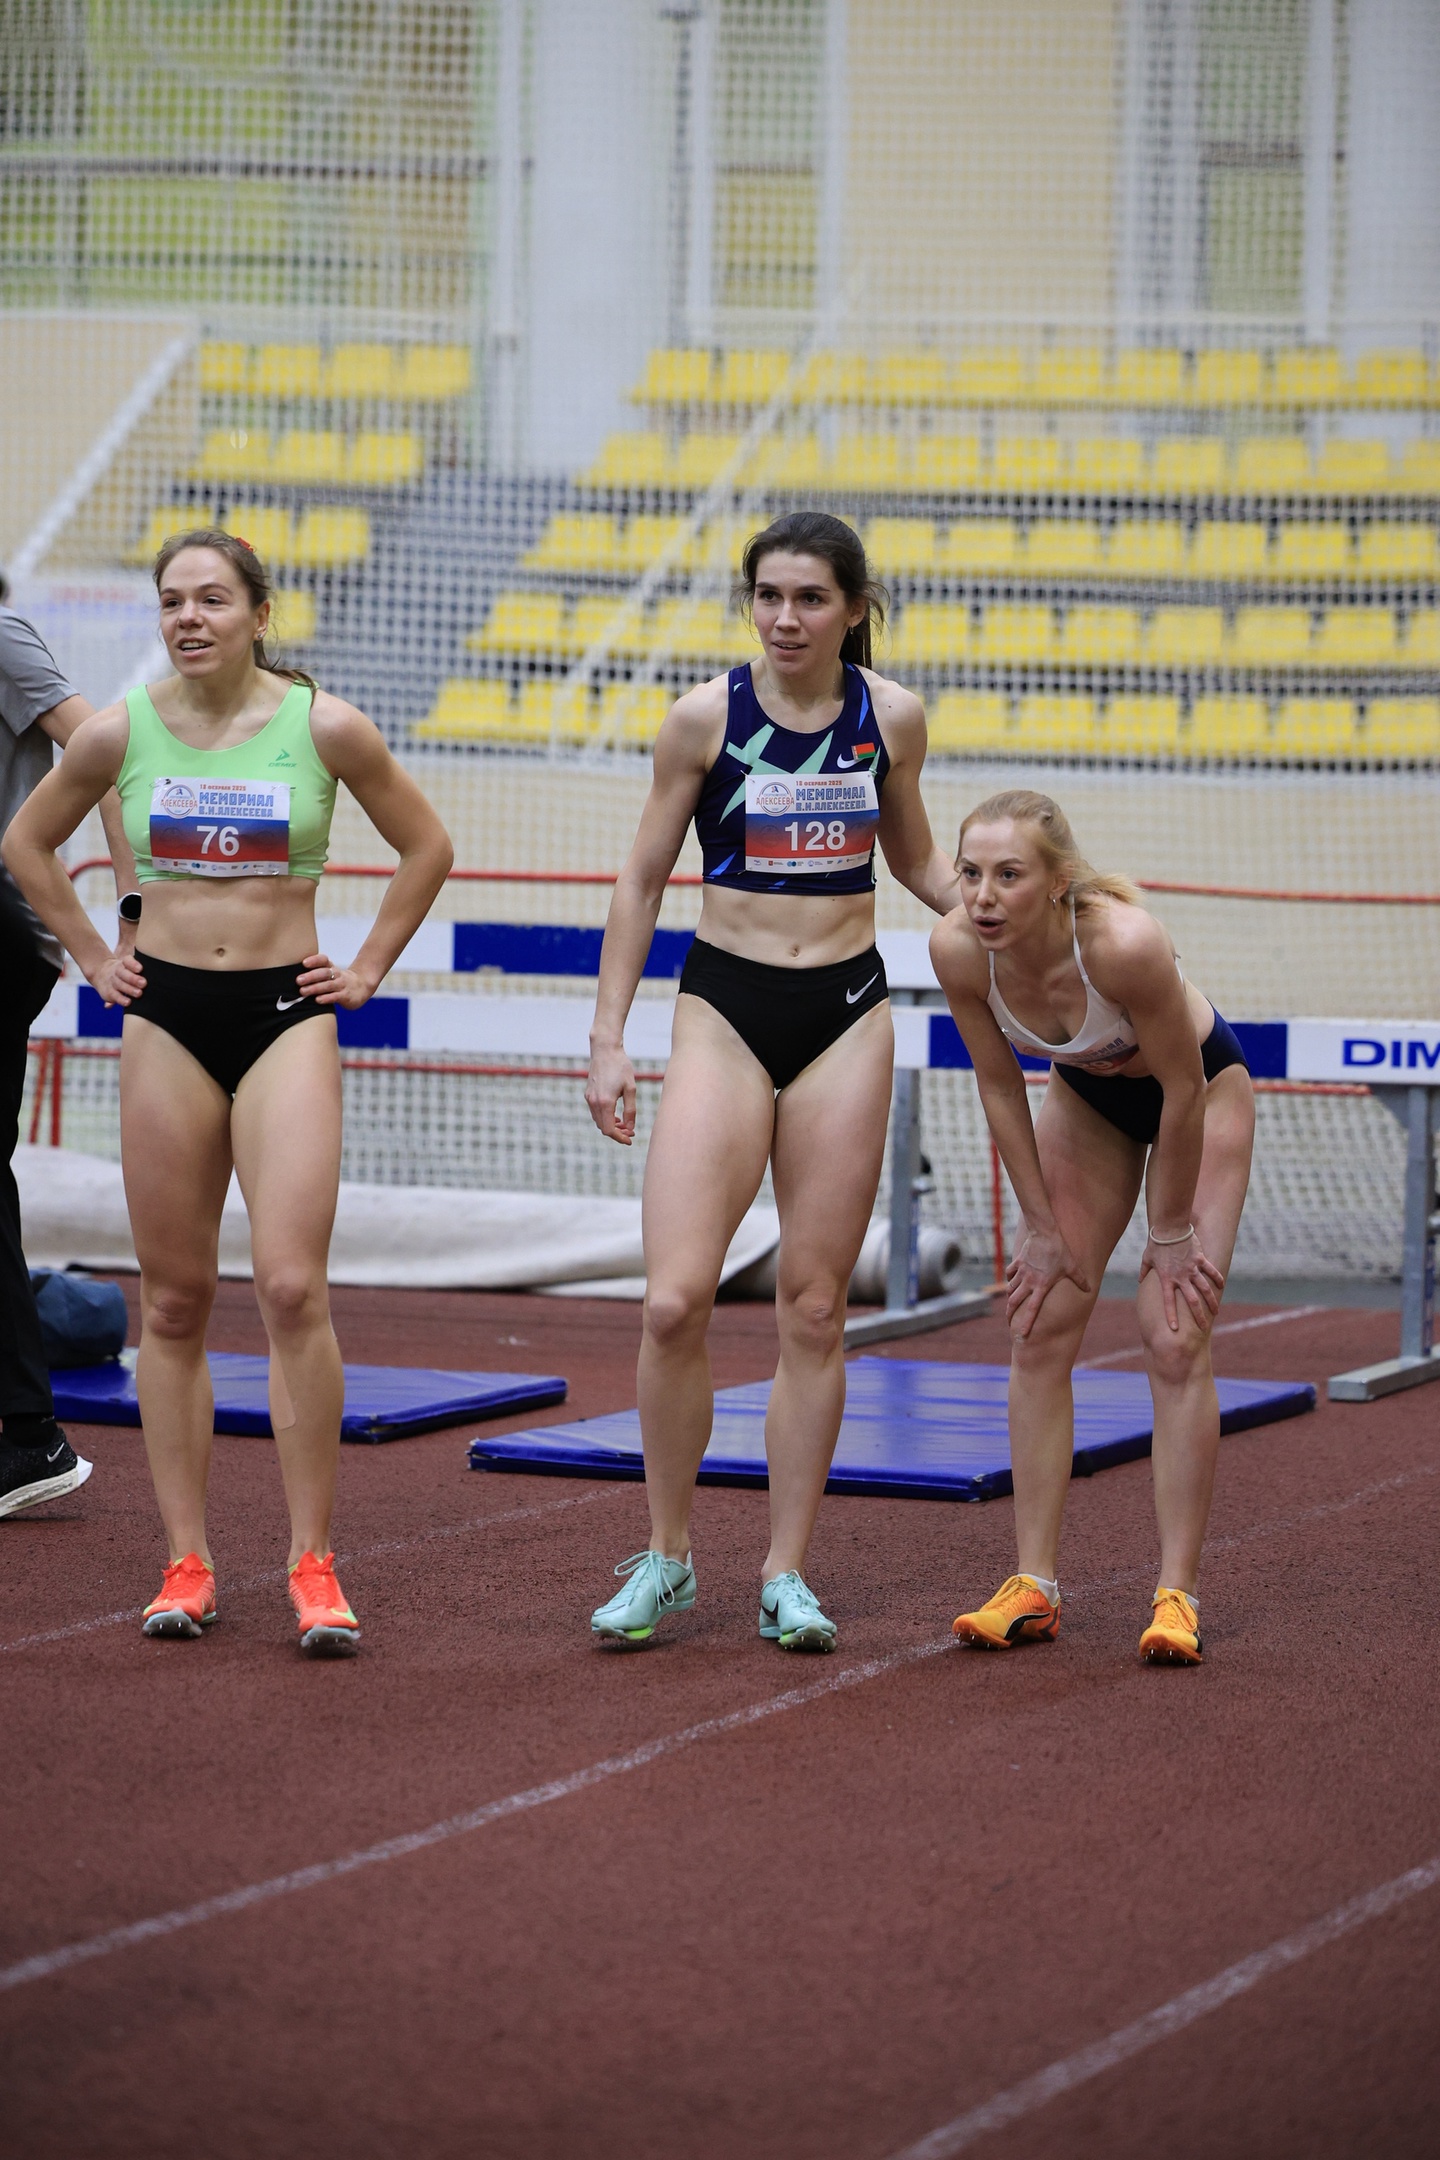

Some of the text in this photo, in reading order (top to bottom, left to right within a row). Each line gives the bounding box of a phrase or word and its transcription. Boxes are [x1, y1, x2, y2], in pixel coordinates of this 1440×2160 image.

[199, 792, 274, 807] МЕМОРИАЛ
[756, 796, 795, 805] АЛЕКСЕЕВА
[795, 786, 866, 801] МЕМОРИАЛ
[160, 799, 198, 808] АЛЕКСЕЕВА
[196, 825, 240, 857] 76
[785, 820, 846, 851] 128
